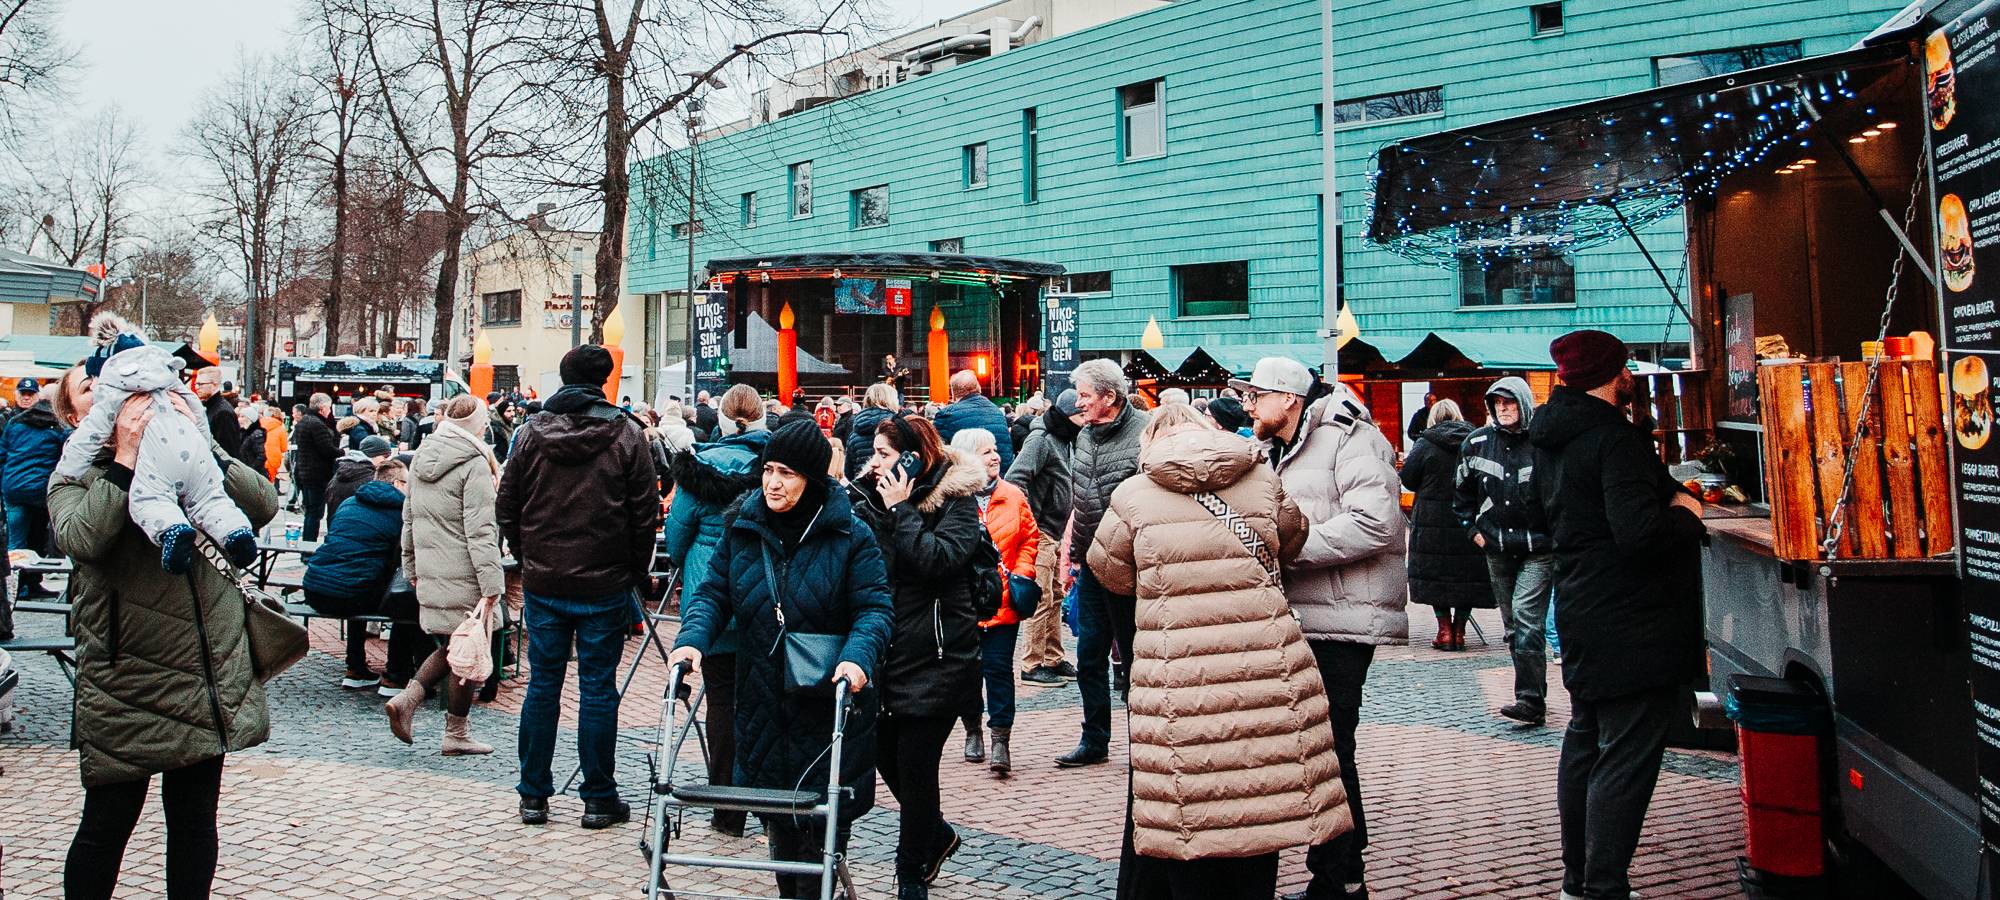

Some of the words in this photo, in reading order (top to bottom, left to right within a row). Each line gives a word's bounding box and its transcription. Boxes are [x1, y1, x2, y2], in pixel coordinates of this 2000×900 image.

[696, 303, 724, 317] NIKO-
[1049, 307, 1076, 320] NIKO-
[698, 315, 723, 330] LAUS
[1051, 320, 1075, 333] LAUS
[700, 332, 721, 345] SIN-
[1052, 336, 1072, 349] SIN-
[701, 345, 721, 359] GEN
[1053, 348, 1072, 361] GEN
